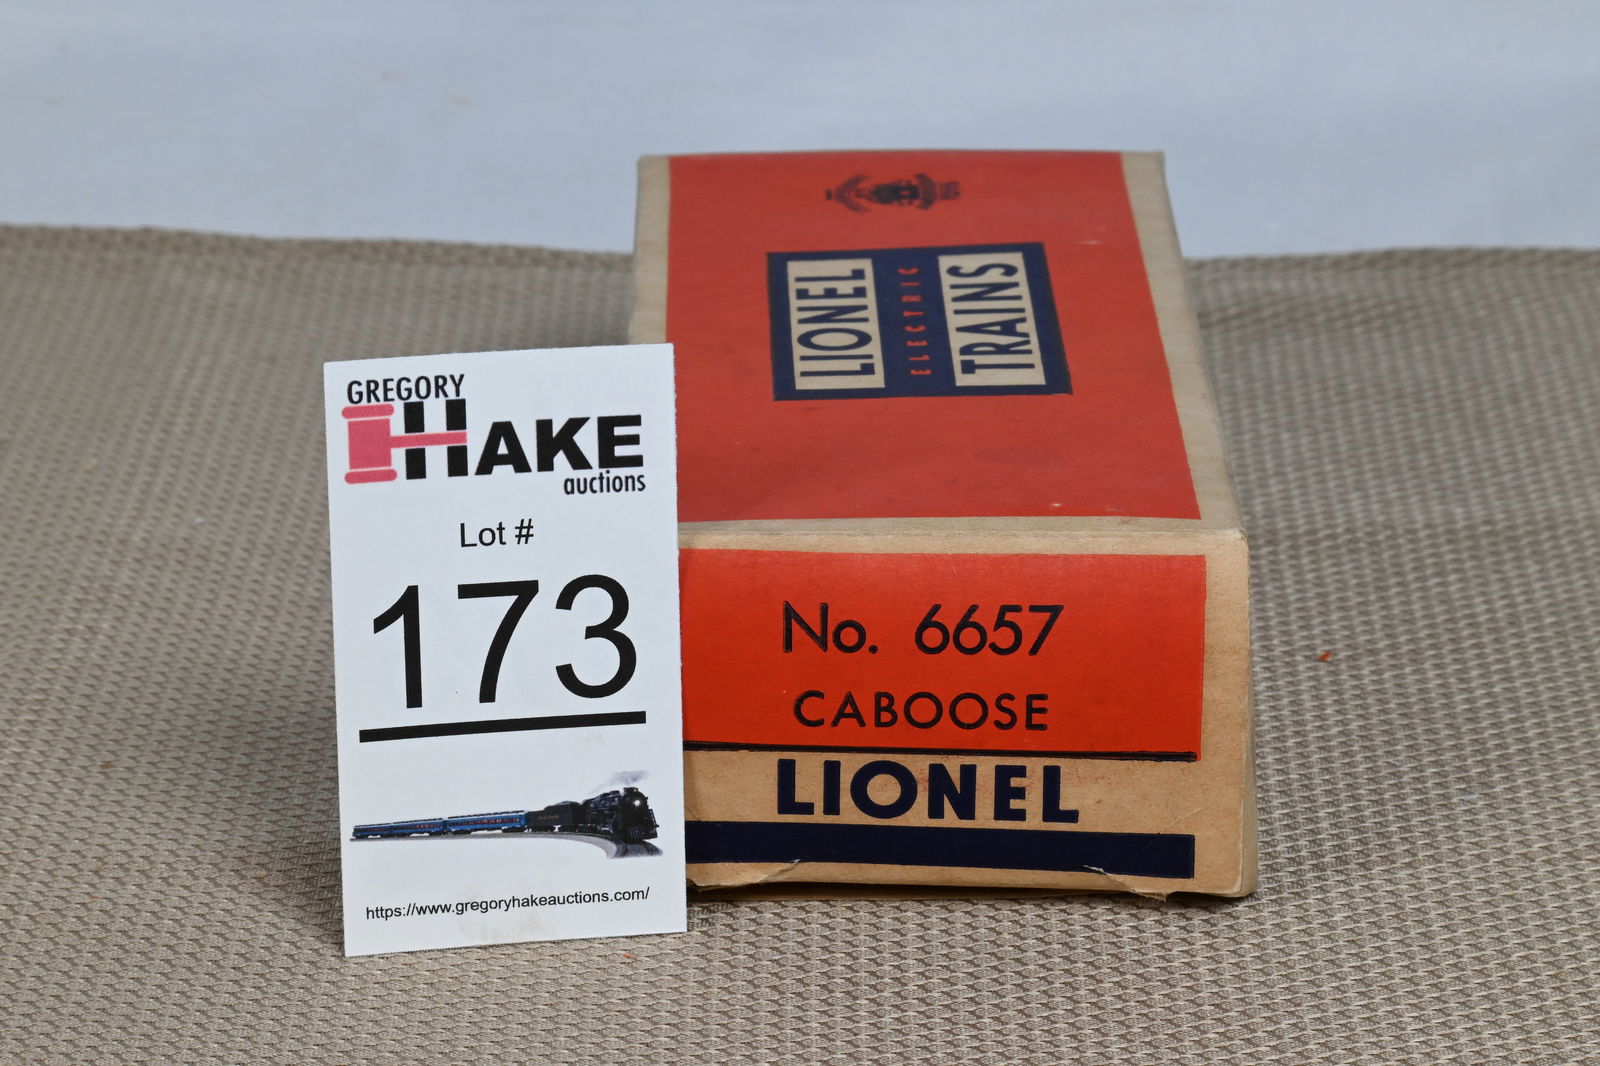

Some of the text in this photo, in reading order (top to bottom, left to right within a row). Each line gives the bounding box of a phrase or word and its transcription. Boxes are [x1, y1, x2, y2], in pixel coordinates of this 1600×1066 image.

[795, 268, 875, 377] LIONEL
[897, 267, 931, 375] ELECTRIC
[946, 263, 1035, 374] TRAINS
[347, 374, 465, 404] GREGORY
[404, 398, 643, 480] HAKE
[563, 470, 646, 495] auctions
[460, 518, 534, 548] Lot #
[373, 574, 637, 709] 173
[783, 601, 1064, 656] No. 6657
[793, 689, 1048, 731] CABOOSE
[777, 758, 1079, 823] LIONEL
[366, 886, 650, 920] https://www.gregoryhakeauctions.com/
